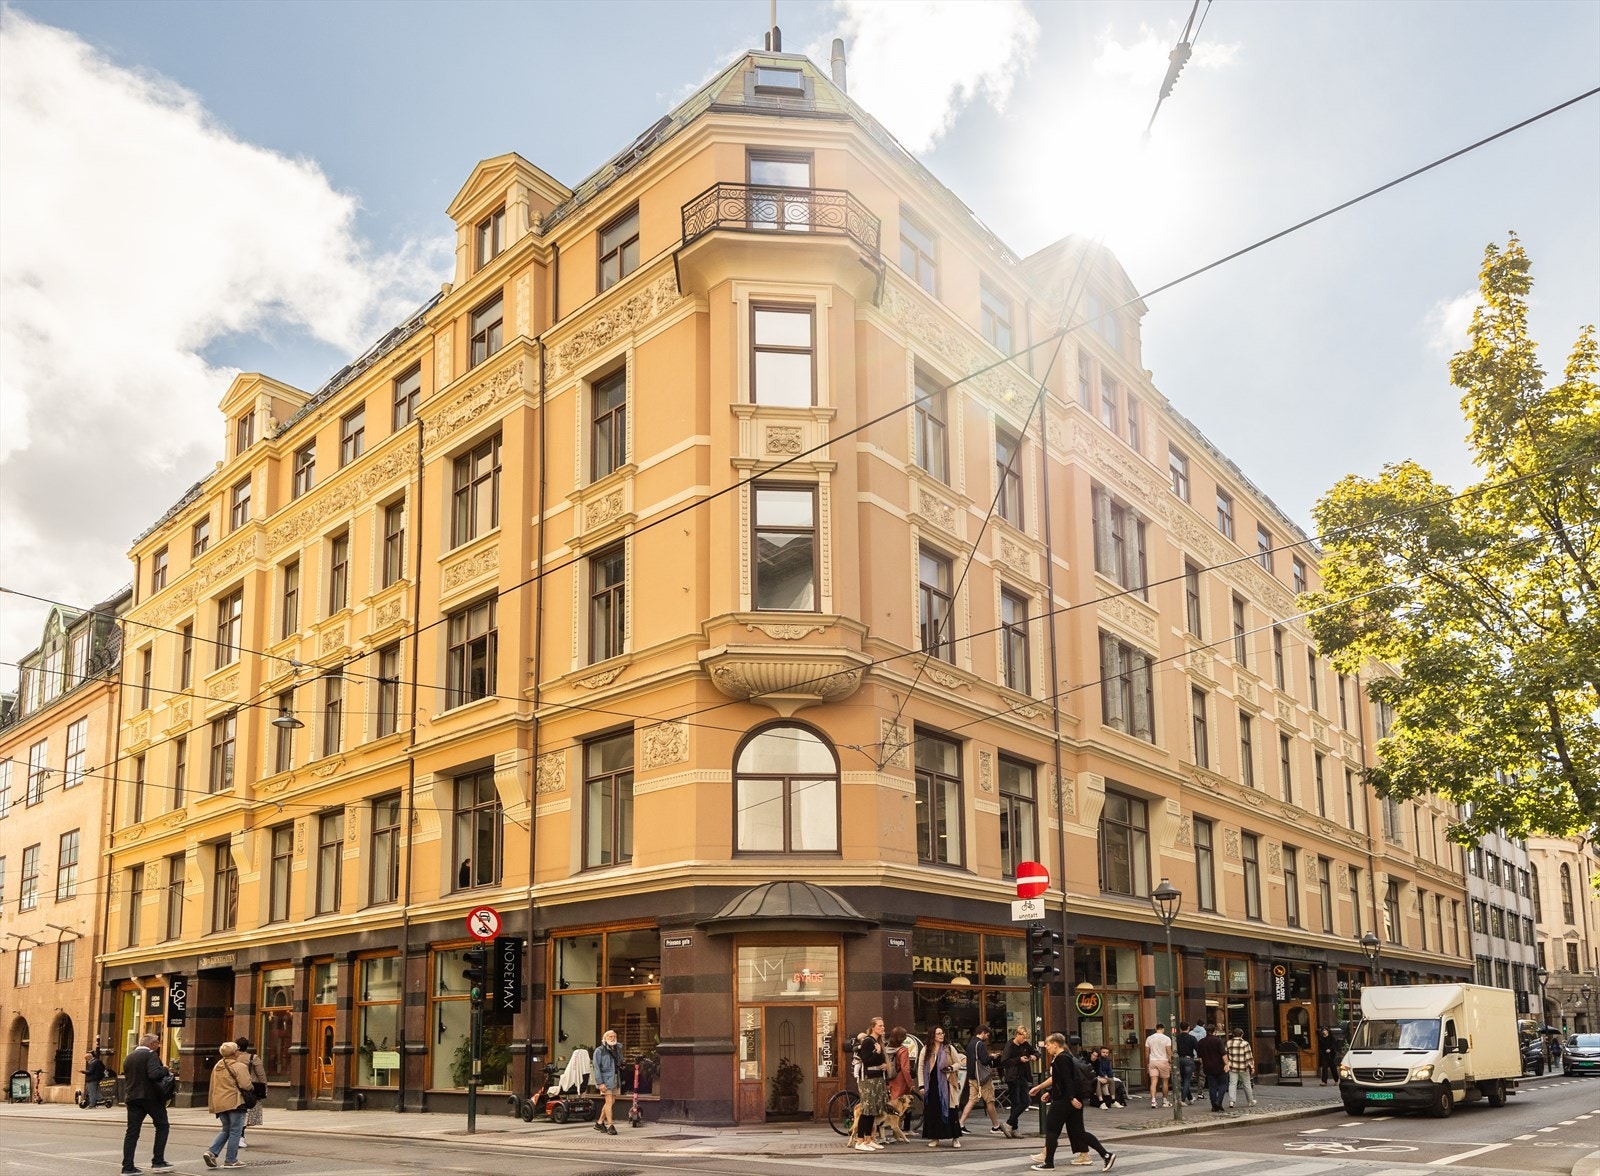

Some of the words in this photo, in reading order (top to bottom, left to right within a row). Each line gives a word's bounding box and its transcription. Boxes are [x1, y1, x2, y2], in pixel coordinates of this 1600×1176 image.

[912, 955, 972, 974] PRINCE
[503, 942, 515, 1009] NOREMAX
[793, 972, 824, 984] GYROS
[823, 1035, 834, 1059] Lunch
[823, 1060, 834, 1075] Bar
